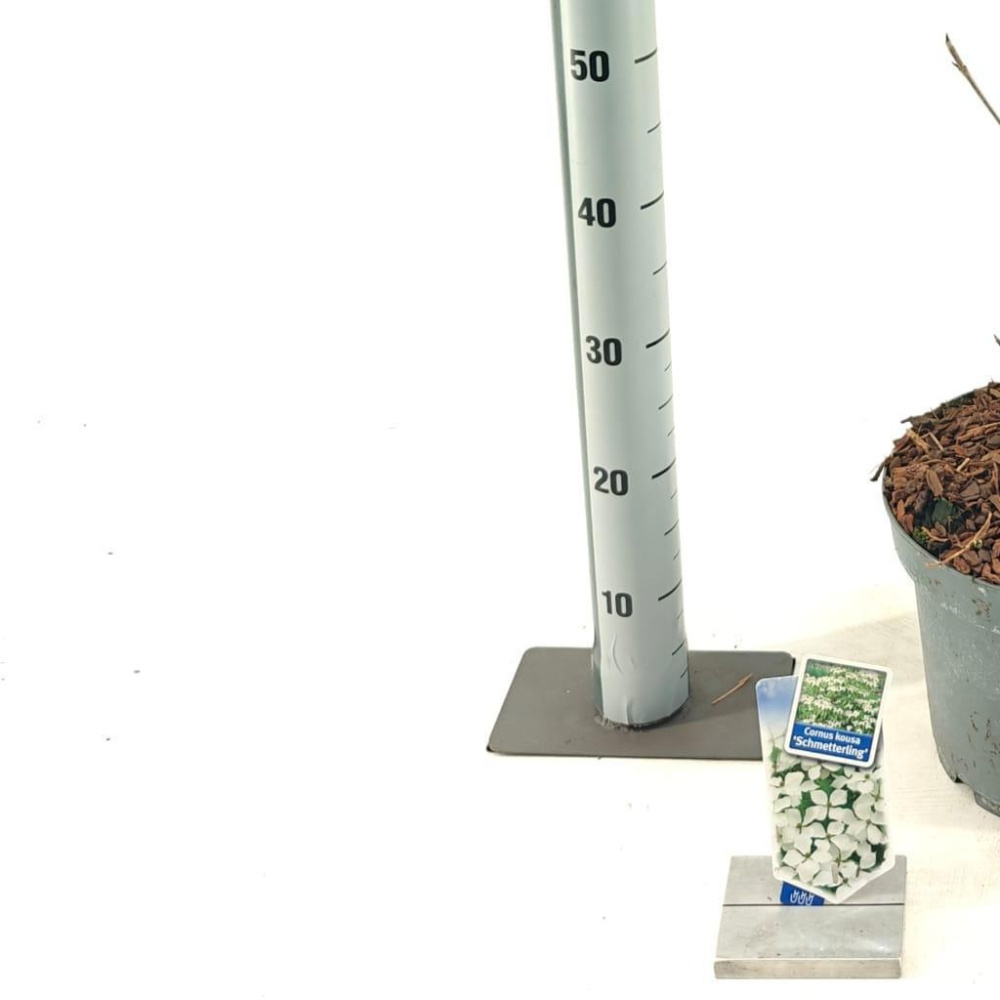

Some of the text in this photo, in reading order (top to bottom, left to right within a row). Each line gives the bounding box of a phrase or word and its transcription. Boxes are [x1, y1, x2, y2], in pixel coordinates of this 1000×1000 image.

[570, 50, 611, 83] 50
[577, 197, 617, 228] 40
[586, 336, 623, 367] 30
[594, 467, 630, 496] 20
[601, 590, 634, 618] 10
[804, 727, 861, 745] Cornus kousa
